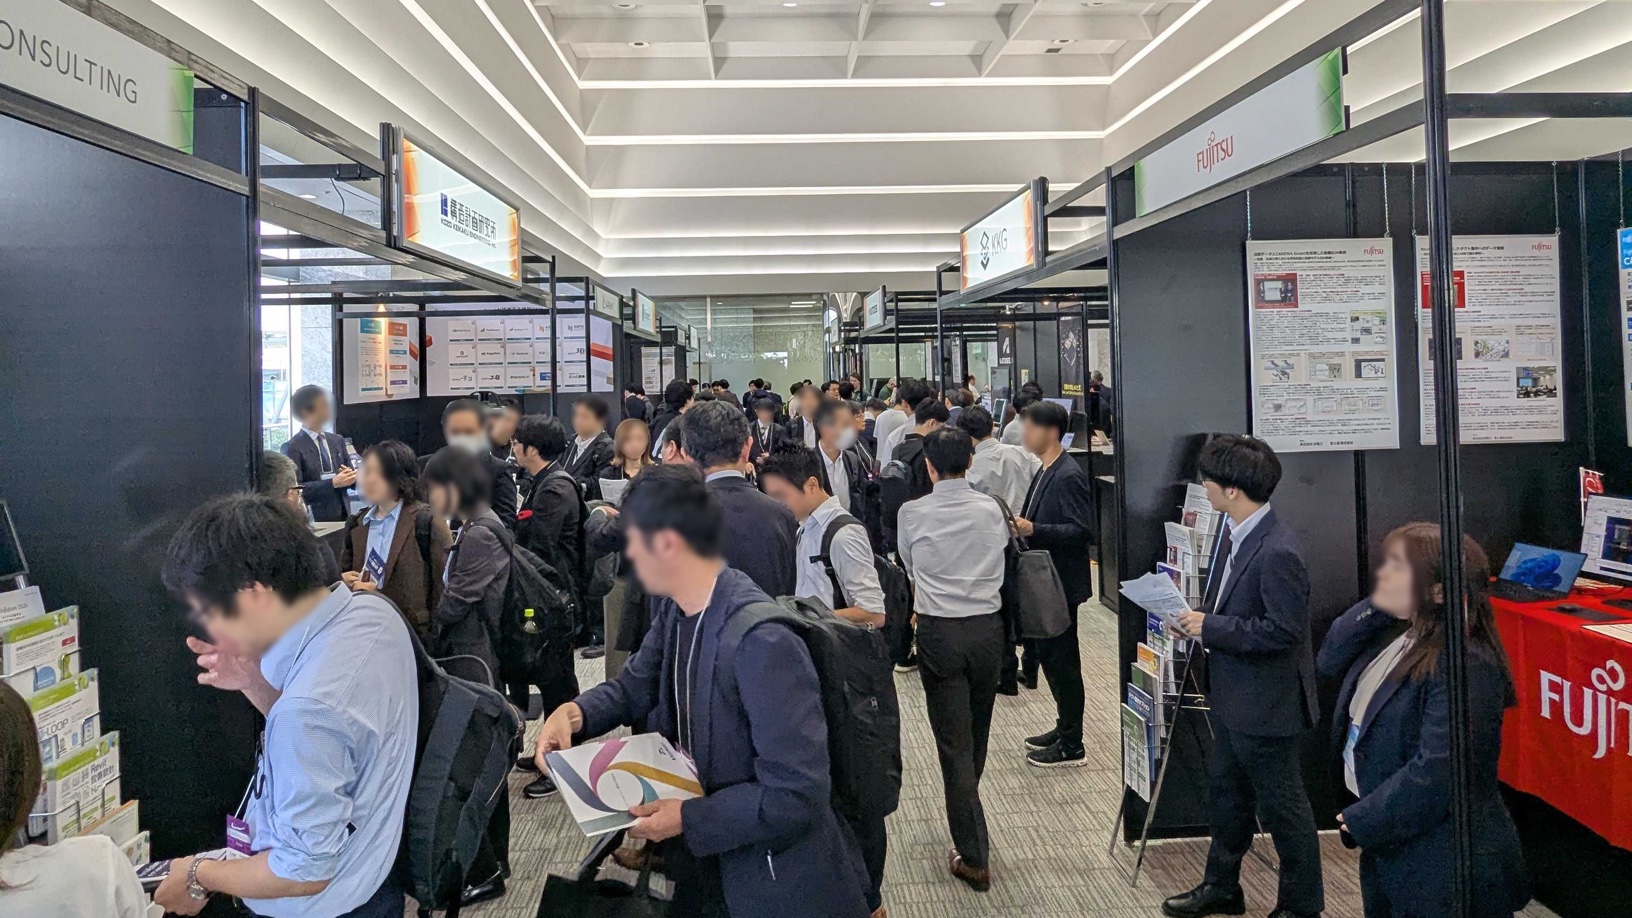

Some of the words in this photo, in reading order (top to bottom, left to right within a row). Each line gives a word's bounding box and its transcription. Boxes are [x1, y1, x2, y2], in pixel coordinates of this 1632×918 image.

[1196, 133, 1234, 173] FUJITSU
[450, 198, 497, 241] 構造計画研究所
[991, 228, 1008, 256] KKG
[1363, 246, 1384, 256] FUJITSU
[1531, 242, 1553, 251] FUJITSU
